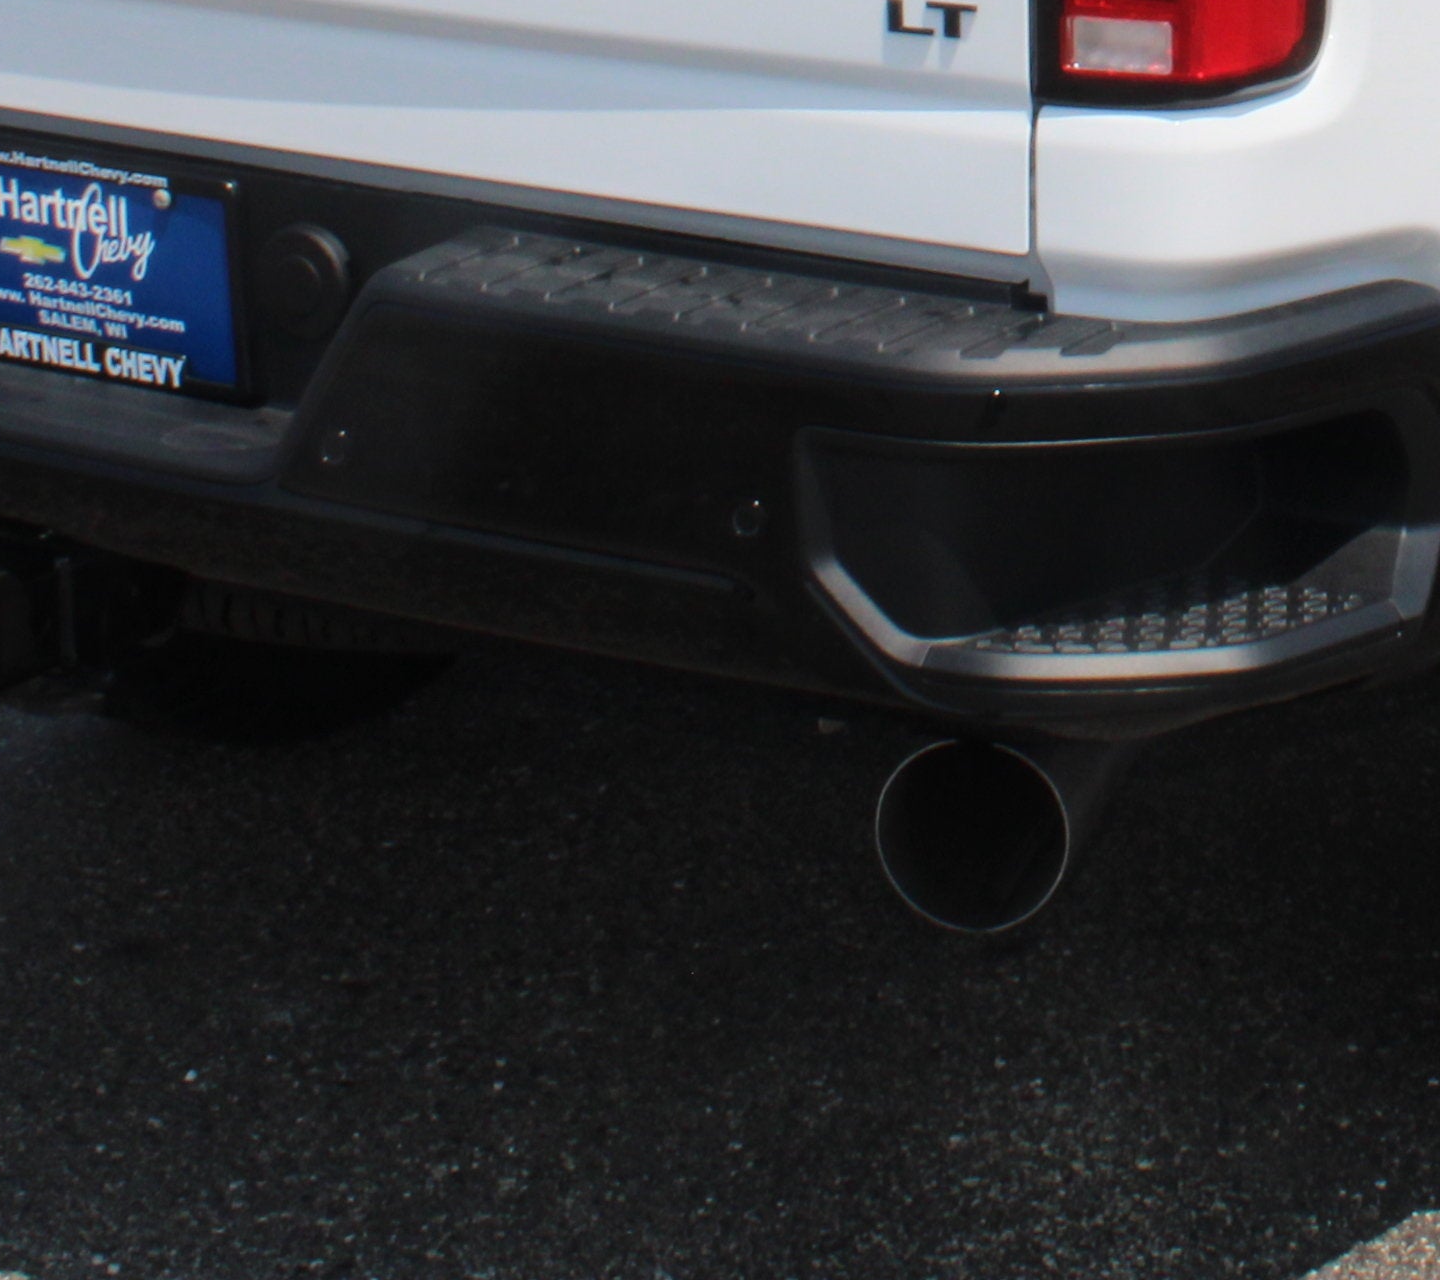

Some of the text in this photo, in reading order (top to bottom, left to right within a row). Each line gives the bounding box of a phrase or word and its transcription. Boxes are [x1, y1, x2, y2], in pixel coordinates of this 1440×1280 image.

[72, 182, 156, 281] Chevy
[23, 273, 134, 306] 262-843-2361
[39, 310, 128, 339] SALEM, WI
[105, 347, 187, 388] CHEVY
